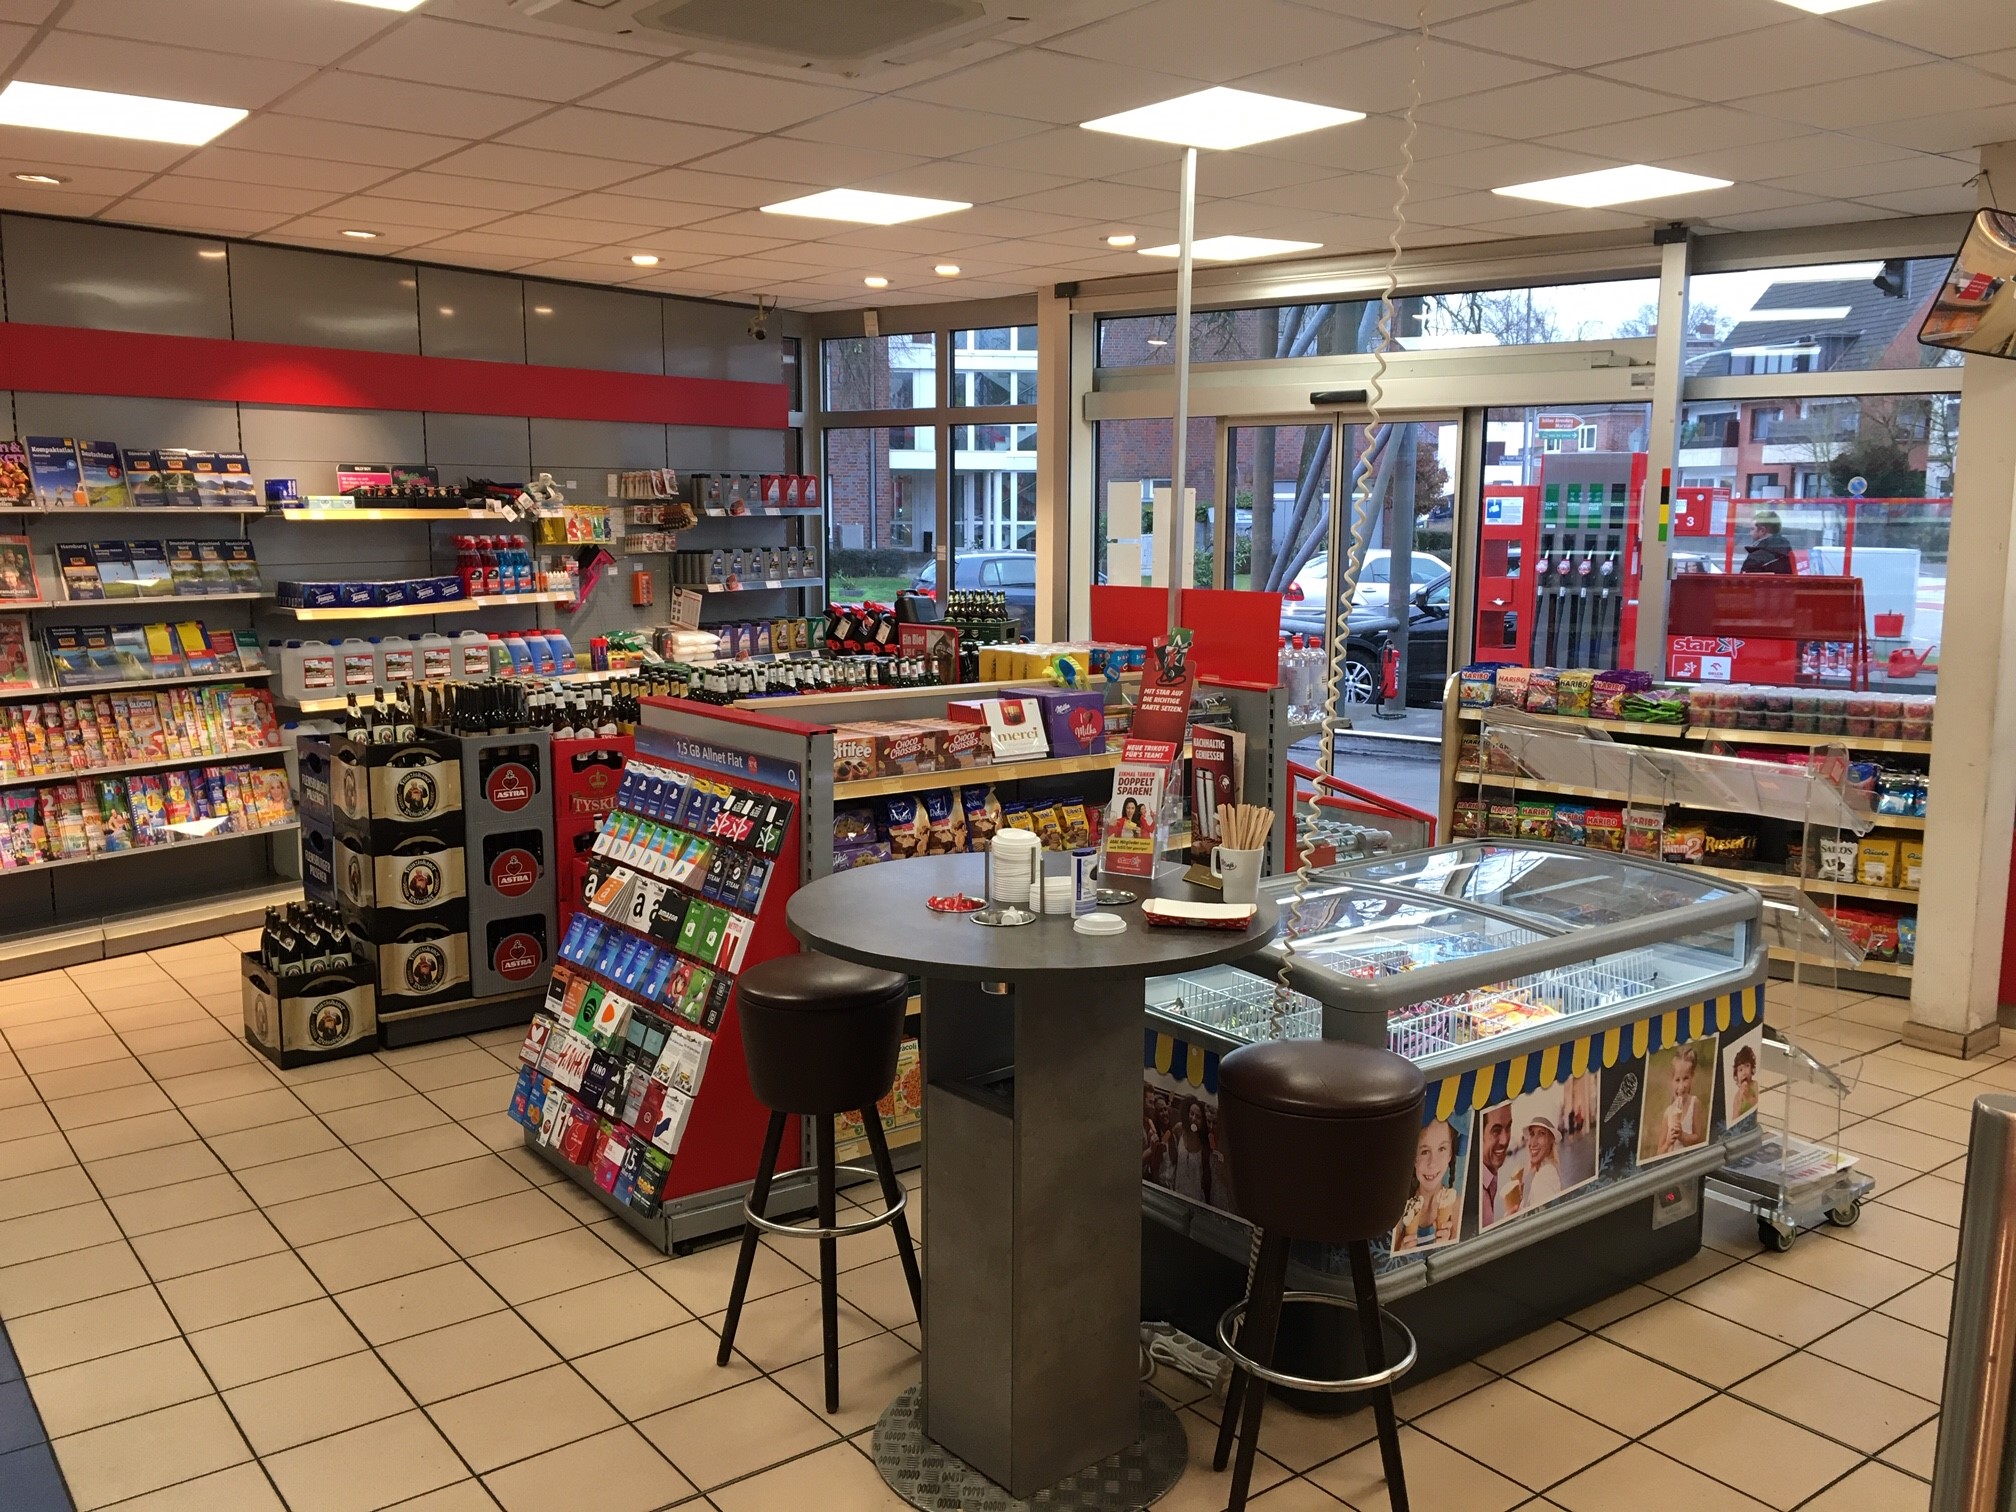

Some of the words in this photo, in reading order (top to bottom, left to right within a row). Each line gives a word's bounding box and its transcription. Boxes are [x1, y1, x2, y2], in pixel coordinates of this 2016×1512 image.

[81, 450, 115, 459] Deutschland
[1686, 516, 1695, 527] 3
[902, 634, 911, 645] Ein
[912, 634, 925, 645] Bier
[1674, 636, 1715, 652] star
[1462, 672, 1491, 681] HARIBO
[1498, 675, 1527, 684] HARIBO
[1560, 680, 1588, 689] HARIBO
[1594, 681, 1627, 691] HARIBO
[1154, 696, 1180, 704] RICHTIGE
[1055, 703, 1071, 714] Milka
[1141, 703, 1160, 711] KARTE
[1161, 705, 1183, 713] SETZEN.
[953, 731, 976, 744] CHOCO
[997, 727, 1038, 742] merci
[1075, 724, 1097, 739] Milka
[895, 736, 919, 750] CHOCO
[948, 737, 979, 754] CROSSIES
[1193, 738, 1225, 749] NACHHALTIG
[677, 740, 688, 756] 1,5
[689, 743, 701, 757] GB
[702, 746, 726, 764] Allnet
[727, 752, 744, 769] Flat
[834, 741, 872, 759] offifee
[890, 743, 922, 760] CROSSIES
[1125, 750, 1143, 758] FÜR'S
[1195, 750, 1224, 761] GENIESSEN
[301, 773, 329, 796] FLENSBURGER
[400, 771, 431, 786] Franziskaner
[1118, 778, 1155, 786] DOPPELT
[306, 788, 325, 806] PILSENER
[496, 788, 526, 799] ASTRA
[1117, 787, 1152, 796] SPAREN!
[573, 797, 618, 813] TYSKI
[1522, 807, 1551, 816] HARIBO
[1587, 816, 1618, 827] HARIBO
[1705, 836, 1745, 853] RIESEN
[1863, 848, 1889, 856] Ricola
[305, 849, 331, 874] FLENSBURGER
[405, 859, 437, 874] Franziskaner
[309, 863, 328, 884] PILSENER
[500, 874, 529, 885] ASTRA
[706, 873, 720, 883] STEAM
[725, 880, 739, 890] STEAM
[632, 892, 645, 919] a
[657, 909, 679, 922] amazon
[1860, 922, 1898, 934] Katjes
[408, 945, 441, 961] Franziskaner
[504, 957, 533, 969] ASTRA
[312, 999, 346, 1015] Franziskaner
[591, 1062, 607, 1077] KINO
[625, 1148, 638, 1170] 15
